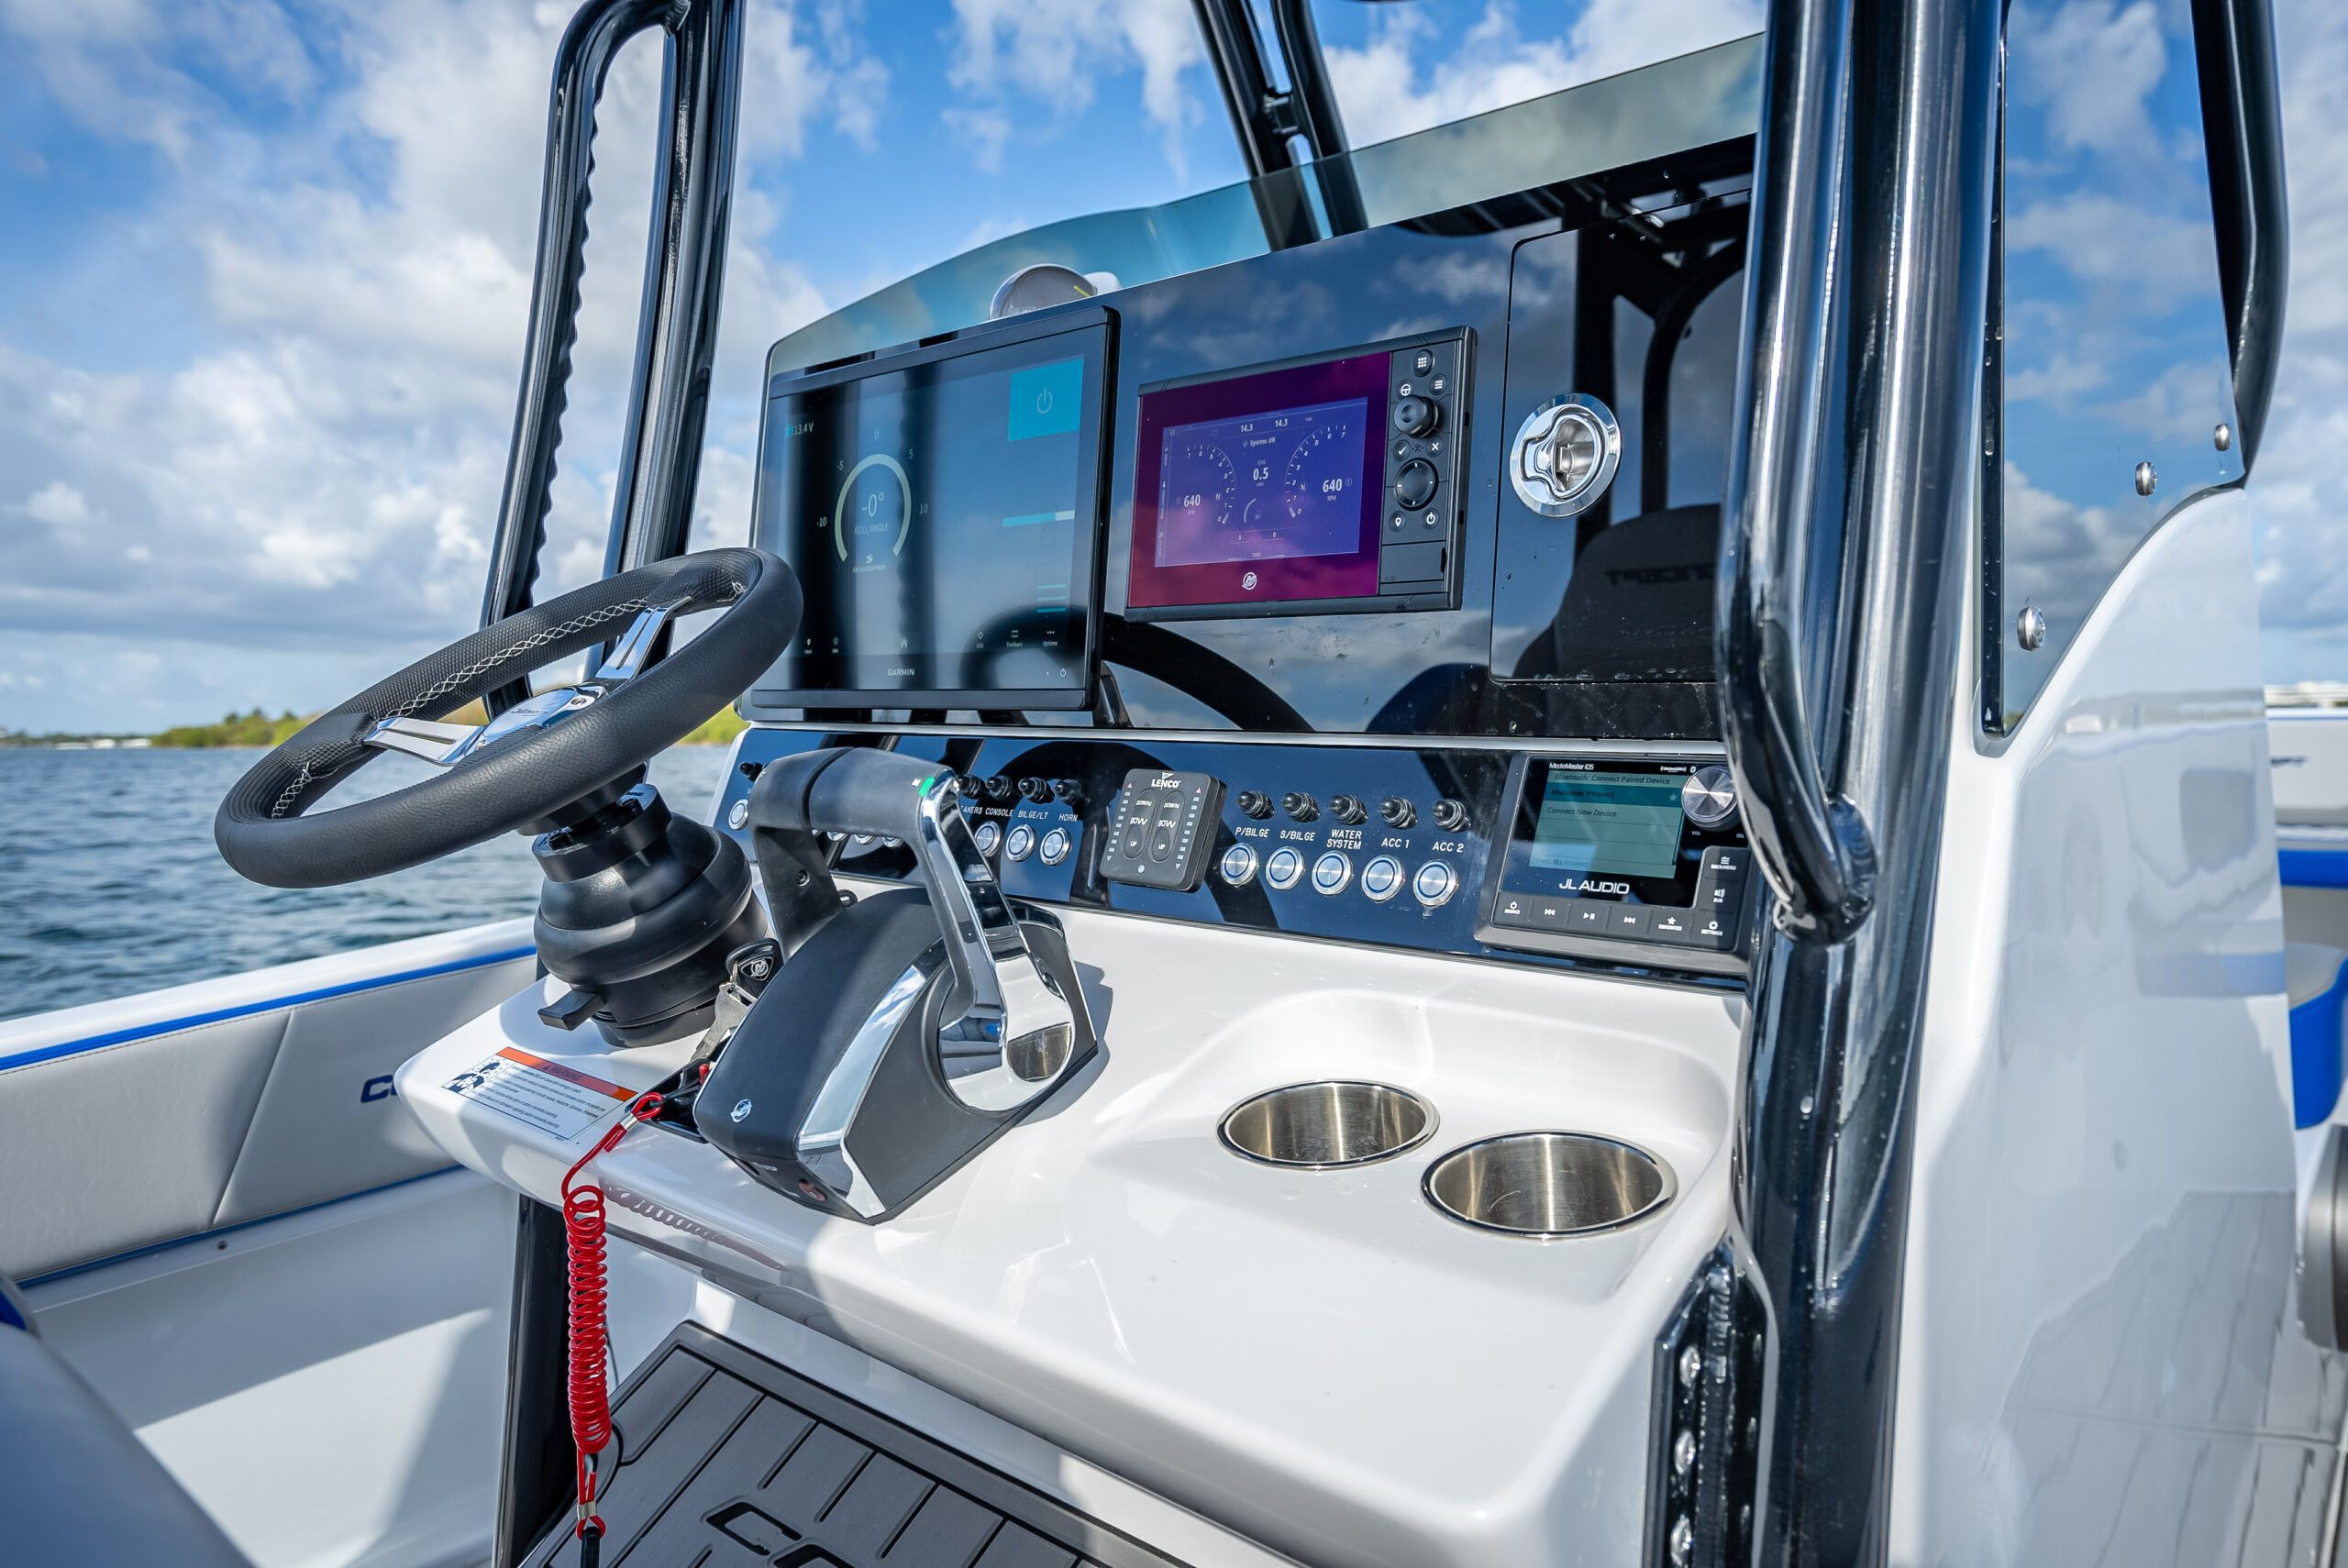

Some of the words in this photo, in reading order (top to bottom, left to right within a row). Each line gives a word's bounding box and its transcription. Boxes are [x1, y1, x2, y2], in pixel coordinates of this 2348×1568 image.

[1241, 424, 1253, 433] 14.3
[1275, 419, 1288, 427] 14.3
[1249, 438, 1267, 447] System
[909, 448, 914, 459] 5
[1253, 467, 1268, 480] 0.5
[1323, 479, 1343, 493] 640
[1183, 494, 1201, 507] 640
[919, 503, 928, 514] 10
[816, 516, 827, 527] -10
[887, 668, 915, 677] GARMIN
[1151, 778, 1180, 790] LENCO
[1591, 775, 1620, 783] Connect
[1622, 776, 1645, 784] Paired
[1645, 777, 1671, 785] Device
[960, 806, 983, 814] AKERS
[985, 807, 1014, 817] CONSOLE
[1547, 807, 1575, 815] Connect
[1577, 808, 1592, 816] New
[1593, 809, 1617, 817] Device
[1058, 813, 1079, 823] HORN
[1129, 816, 1148, 826] BOW
[1157, 819, 1177, 829] BOW
[1235, 827, 1269, 838] P/BILGE
[1279, 830, 1315, 842] S/BILGE
[1331, 829, 1362, 840] WATER
[1326, 839, 1362, 850] SYSTEM
[1381, 838, 1402, 848] ACC
[1405, 839, 1410, 849] 1
[1432, 841, 1454, 852] ACC
[1456, 843, 1465, 853] 2
[1558, 878, 1578, 890] JL
[1578, 879, 1630, 895] AUDIO
